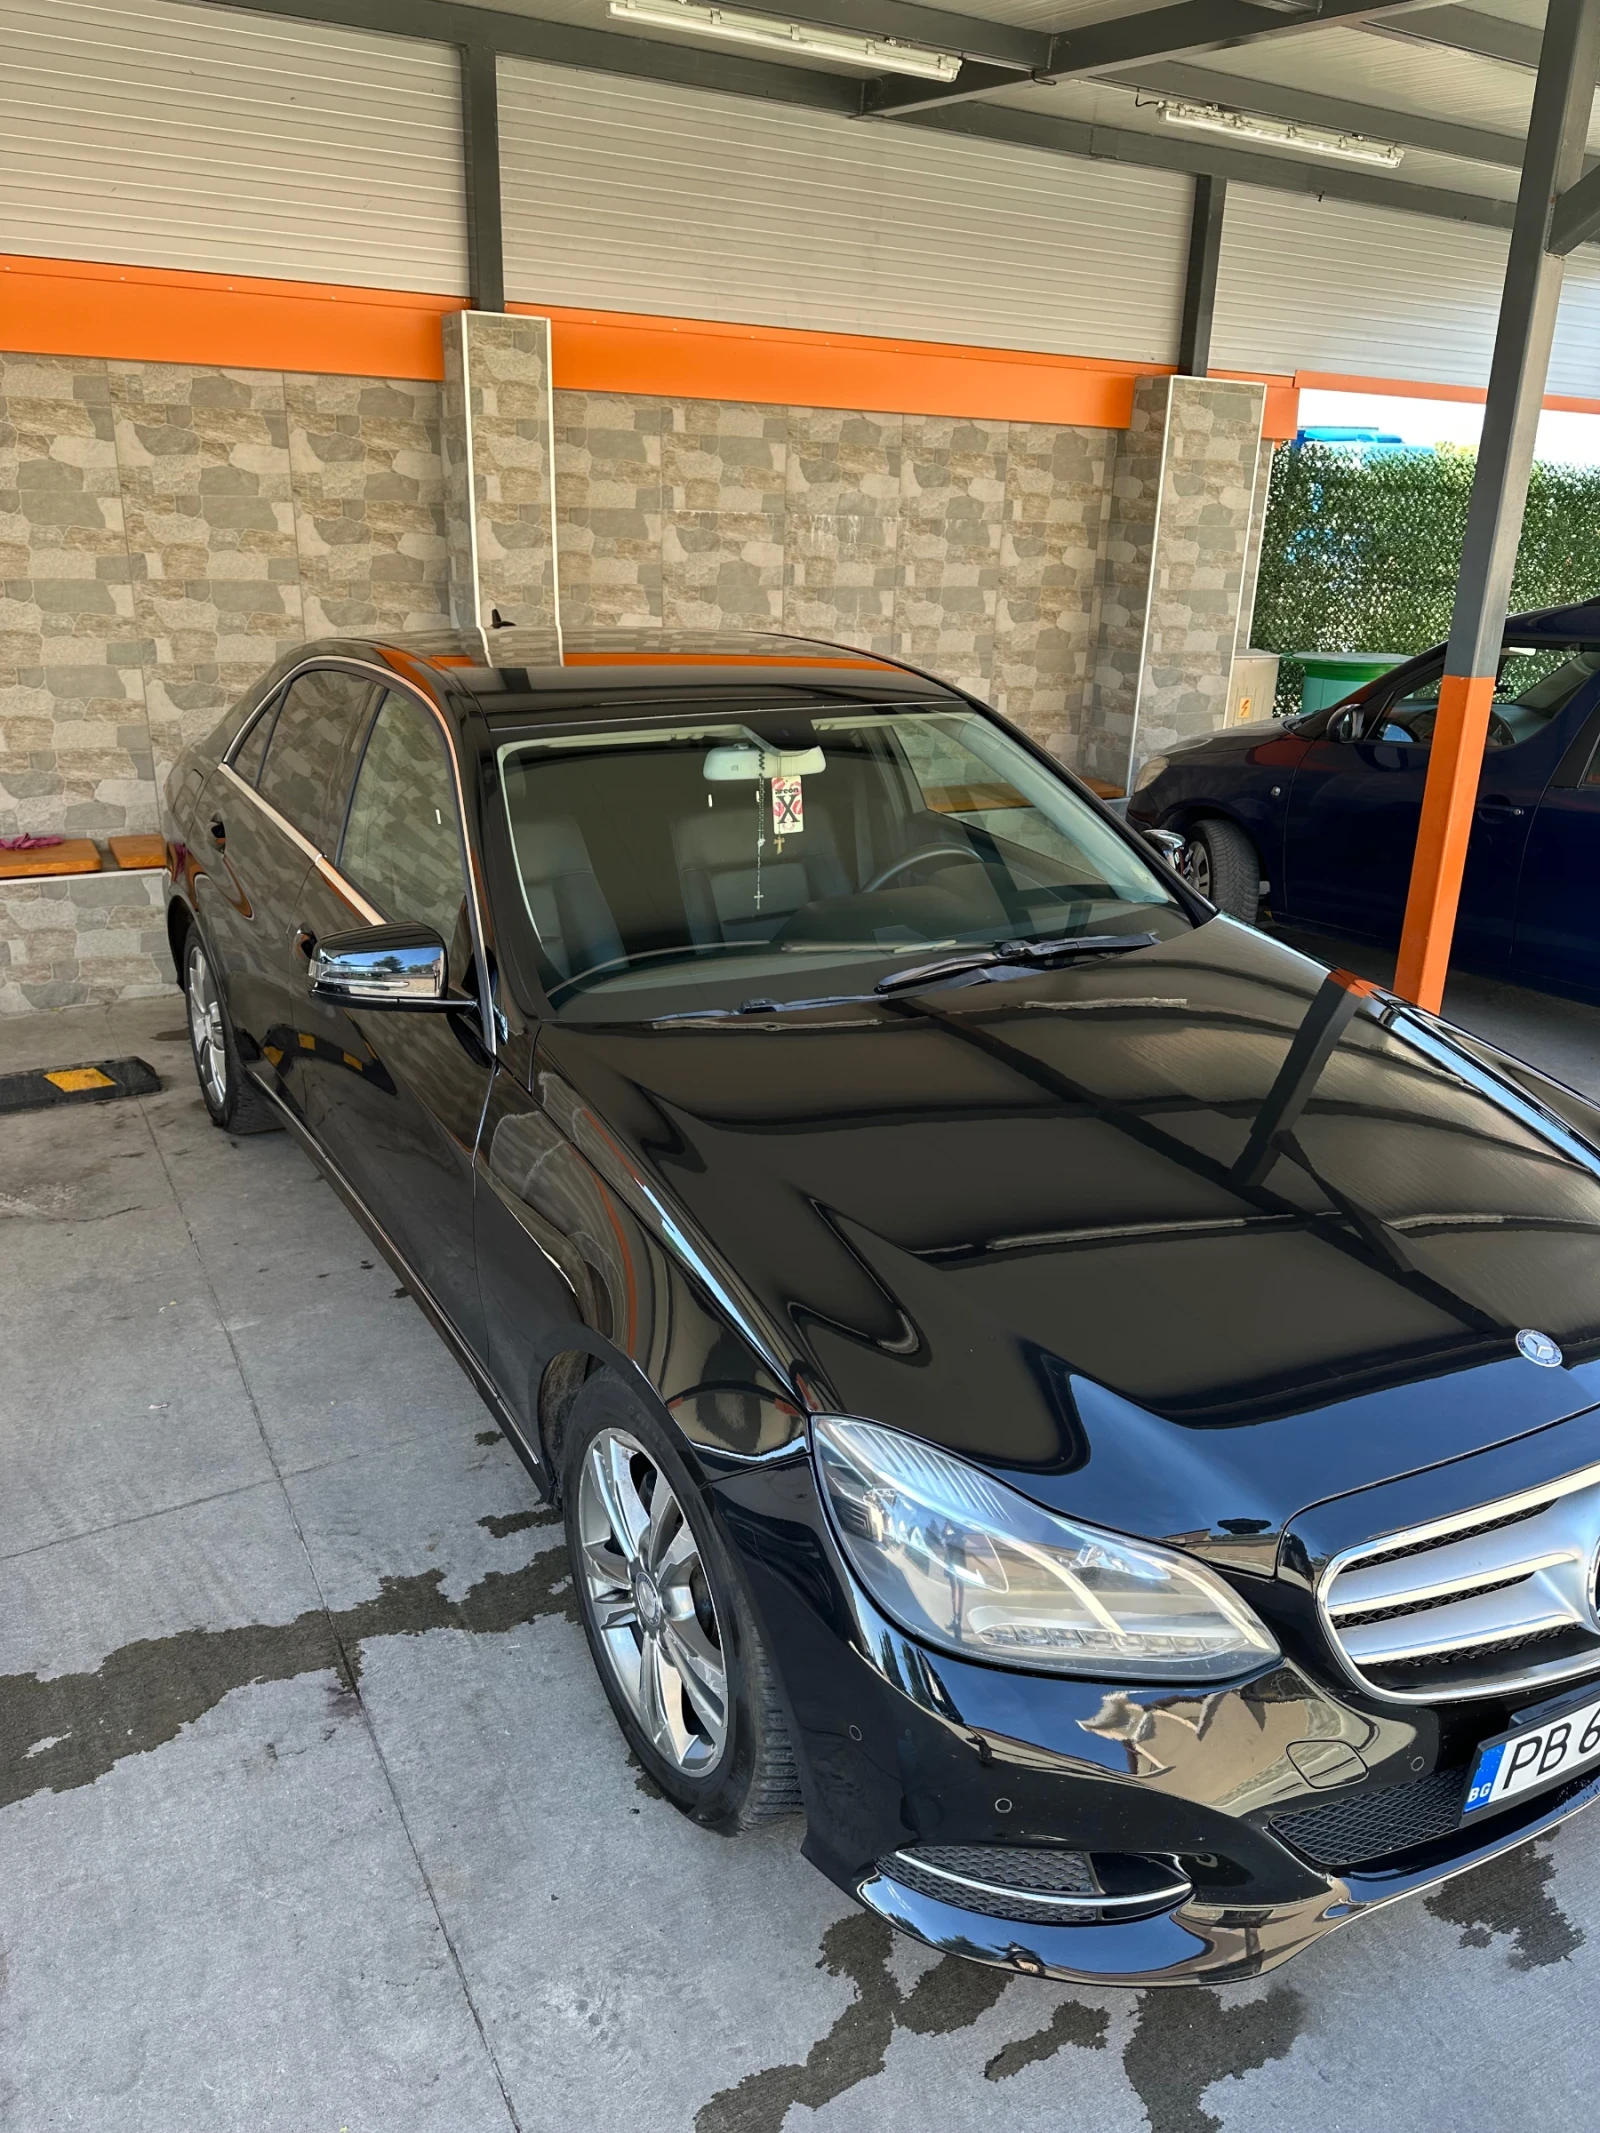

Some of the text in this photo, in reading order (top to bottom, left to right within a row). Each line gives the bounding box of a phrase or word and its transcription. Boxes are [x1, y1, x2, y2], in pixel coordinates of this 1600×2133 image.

[775, 787, 799, 795] areon
[776, 794, 801, 824] X
[1502, 1722, 1572, 1790] PB
[1468, 1782, 1492, 1803] BG
